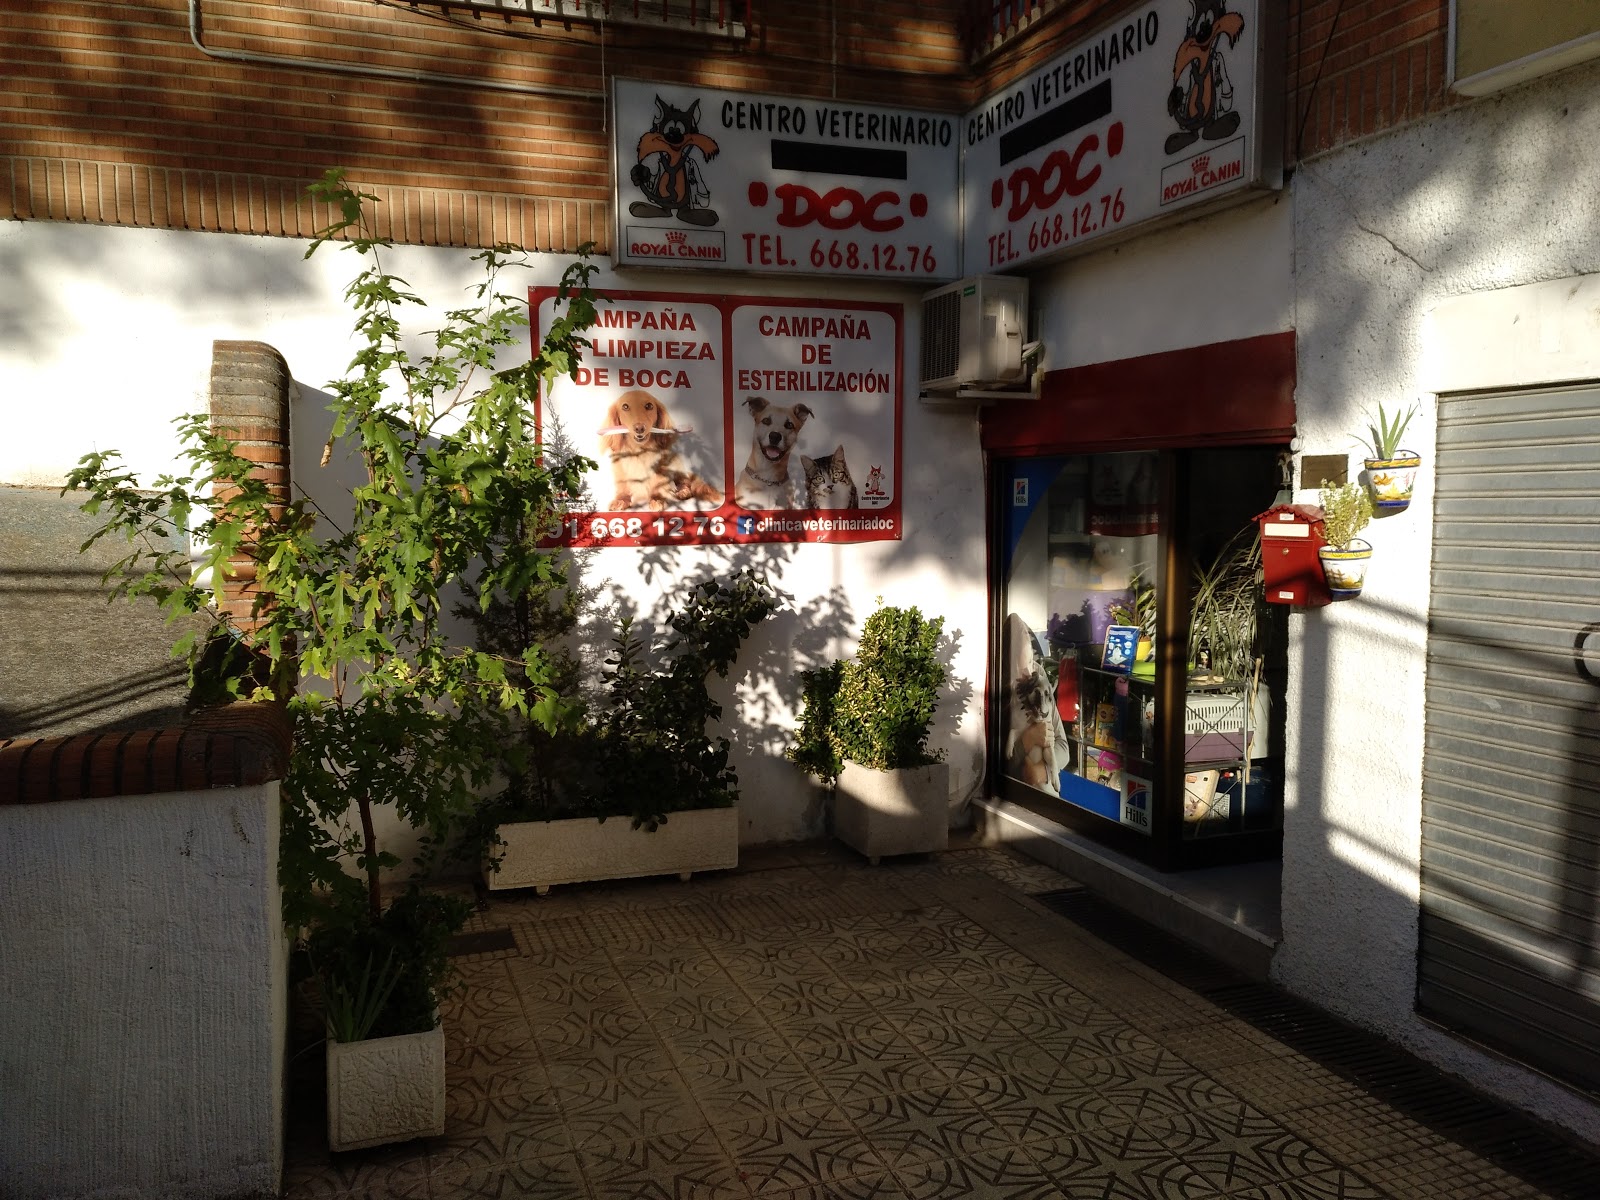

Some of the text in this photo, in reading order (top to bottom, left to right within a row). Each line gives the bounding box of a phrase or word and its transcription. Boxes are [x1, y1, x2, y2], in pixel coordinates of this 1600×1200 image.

[967, 10, 1159, 146] CENTRO VETERINARIO
[721, 99, 952, 148] CENTRO VETERINARIO
[1163, 159, 1241, 201] ROYAL CANIN
[988, 187, 1126, 267] TEL. 668.12.76
[631, 242, 722, 259] ROYAL CANIN
[742, 233, 937, 273] TEL. 668.12.76
[758, 314, 872, 341] CAMPAÑA
[592, 338, 716, 361] LIMPIEZA
[801, 344, 832, 365] DE
[576, 367, 692, 389] DE BOCA
[738, 368, 890, 394] ESTERILIZACIÓN
[590, 517, 643, 539] 668
[652, 517, 685, 537] 12
[693, 516, 726, 536] 76
[756, 516, 895, 532] clinicaveterinariadoc
[1125, 806, 1148, 827] Hill's
